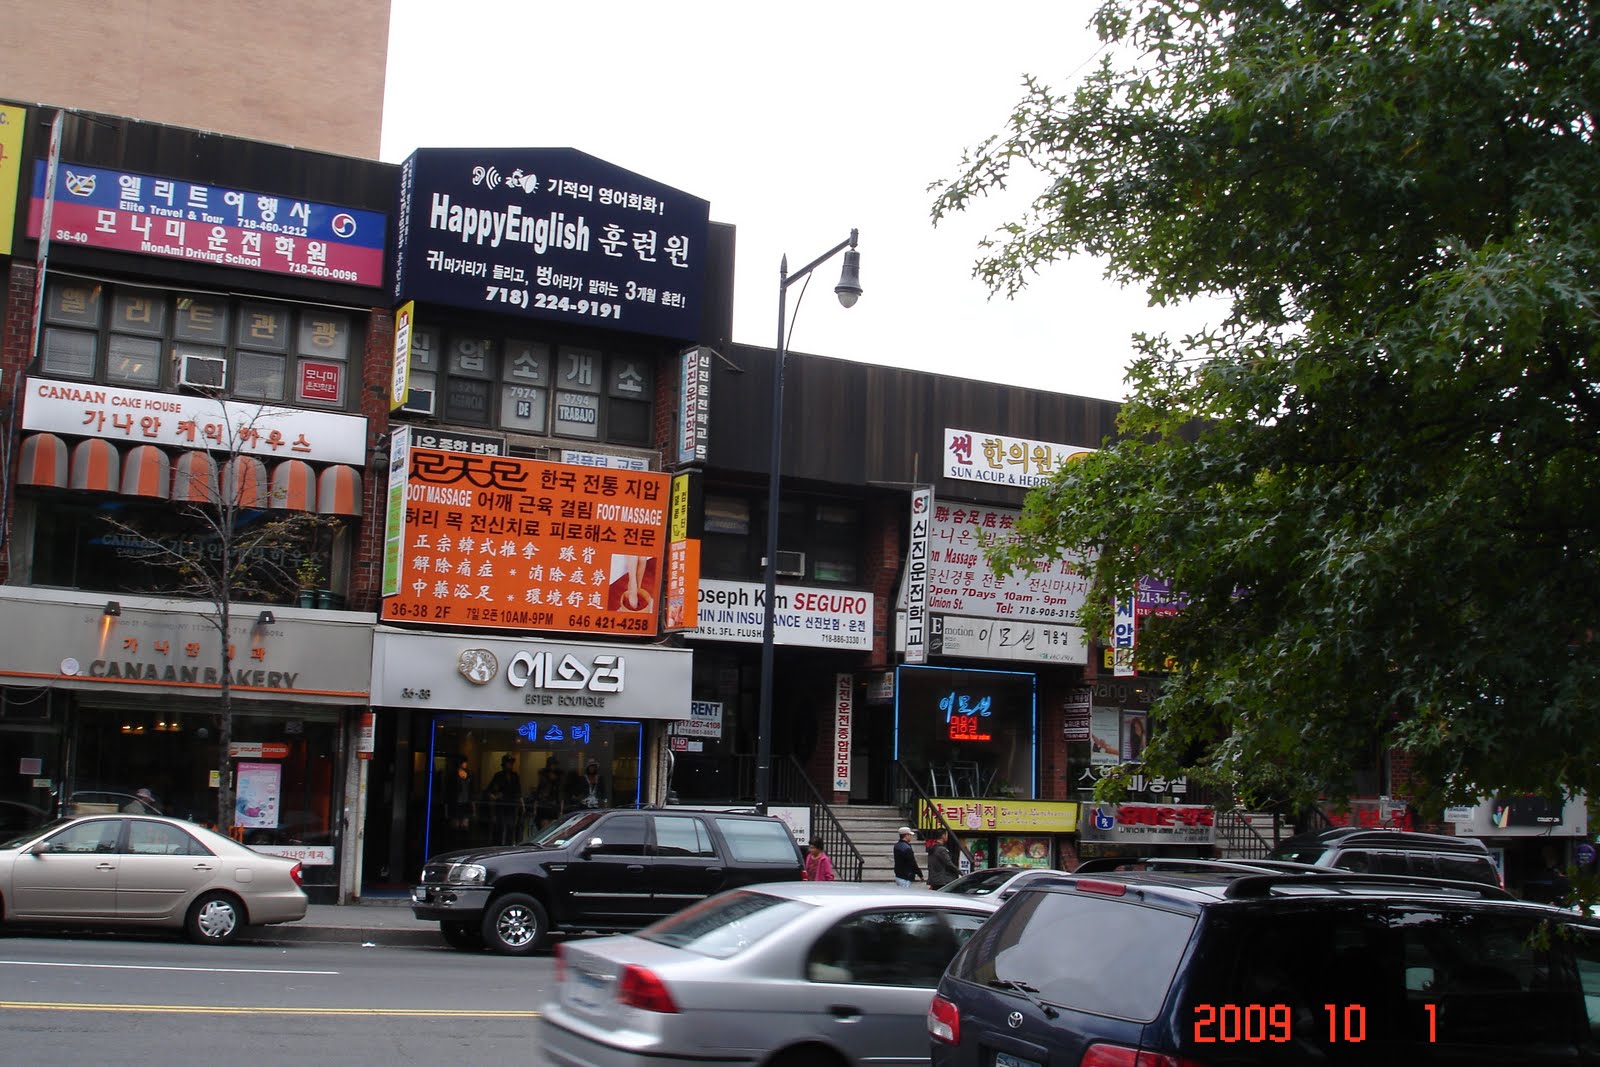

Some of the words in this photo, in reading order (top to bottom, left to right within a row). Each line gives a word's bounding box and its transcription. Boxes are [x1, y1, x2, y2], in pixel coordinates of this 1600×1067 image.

[548, 178, 594, 202] 기적의
[598, 186, 664, 216] 영어회화!
[95, 210, 186, 246] 모나미
[120, 201, 145, 214] Elite
[150, 205, 183, 218] Travel
[188, 210, 197, 220] &
[201, 212, 224, 224] Tour
[237, 218, 308, 238] 718-460-1212
[430, 192, 591, 255] HappyEnglish
[598, 223, 690, 269] 훈련원
[56, 230, 88, 243] 36-40
[141, 241, 184, 257] MonAmi
[186, 247, 223, 264] Driving
[225, 252, 261, 268] School
[288, 262, 358, 282] 718-460-0096
[426, 250, 488, 279] 귀머거리가
[492, 264, 530, 286] 들리고,
[536, 265, 584, 292] 벙어리가
[588, 278, 619, 298] 말하는
[624, 281, 656, 304] 3개월
[661, 290, 686, 309] 훈련!
[486, 285, 529, 310] 718)
[534, 292, 622, 320] 224-9191
[306, 369, 338, 383] 모나미
[38, 384, 106, 405] CANAAN
[111, 395, 142, 409] CAKE
[144, 399, 182, 414] HOUSE
[510, 386, 537, 400] 7974
[564, 393, 590, 406] 9794
[517, 402, 530, 418] DE
[559, 406, 596, 424] TRABAJO
[82, 410, 162, 438] 가나안
[239, 426, 312, 453] 하우스
[981, 438, 1055, 476] 한의원
[540, 470, 578, 494] 한국
[582, 474, 619, 497] 전통
[625, 478, 660, 501] 지압
[951, 466, 972, 478] SUN
[976, 470, 1005, 482] ACUP.
[1008, 474, 1016, 484] &
[407, 483, 426, 503] OOT
[426, 486, 473, 509] MASSAGE
[478, 492, 512, 513] 어깨
[518, 495, 553, 517] 근육
[559, 498, 592, 520] 결림
[596, 502, 620, 522] FOOT
[620, 505, 662, 527] MASSAGE
[934, 506, 1022, 530] 聯合足底按
[444, 511, 463, 532] 목
[468, 514, 541, 538] 전신치료
[549, 520, 618, 544] 피로해소
[622, 526, 656, 548] 전문
[944, 548, 978, 568] Massage
[908, 519, 928, 646] 신진운전학교
[698, 588, 748, 609] oseph
[754, 589, 788, 609] Km
[793, 592, 867, 616] SEGURO
[929, 596, 952, 609] Union
[954, 598, 964, 610] St.
[962, 588, 996, 600] 7Days
[1004, 592, 1033, 602] 10am
[1044, 595, 1068, 606] 9pm
[996, 602, 1014, 614] Tel:
[391, 602, 428, 619] 36-38
[434, 605, 451, 620] 2F
[466, 606, 480, 621] 7일
[482, 608, 498, 622] 오픈
[500, 610, 554, 626] 10AM-9PM
[568, 614, 590, 628] 646
[594, 616, 649, 632] 421-4258
[698, 609, 714, 622] HIN
[718, 610, 734, 623] JIN
[736, 612, 800, 628] INSUANCE
[805, 616, 840, 630] 신진보험
[848, 618, 866, 632] 운전
[737, 630, 775, 638] FLUSHI
[122, 638, 200, 658] 가나안
[89, 660, 199, 683] CANAAN
[402, 686, 431, 700] 36-38
[525, 694, 553, 706] ESTER
[558, 696, 606, 708] BOUTIQUE
[690, 702, 720, 716] RENT
